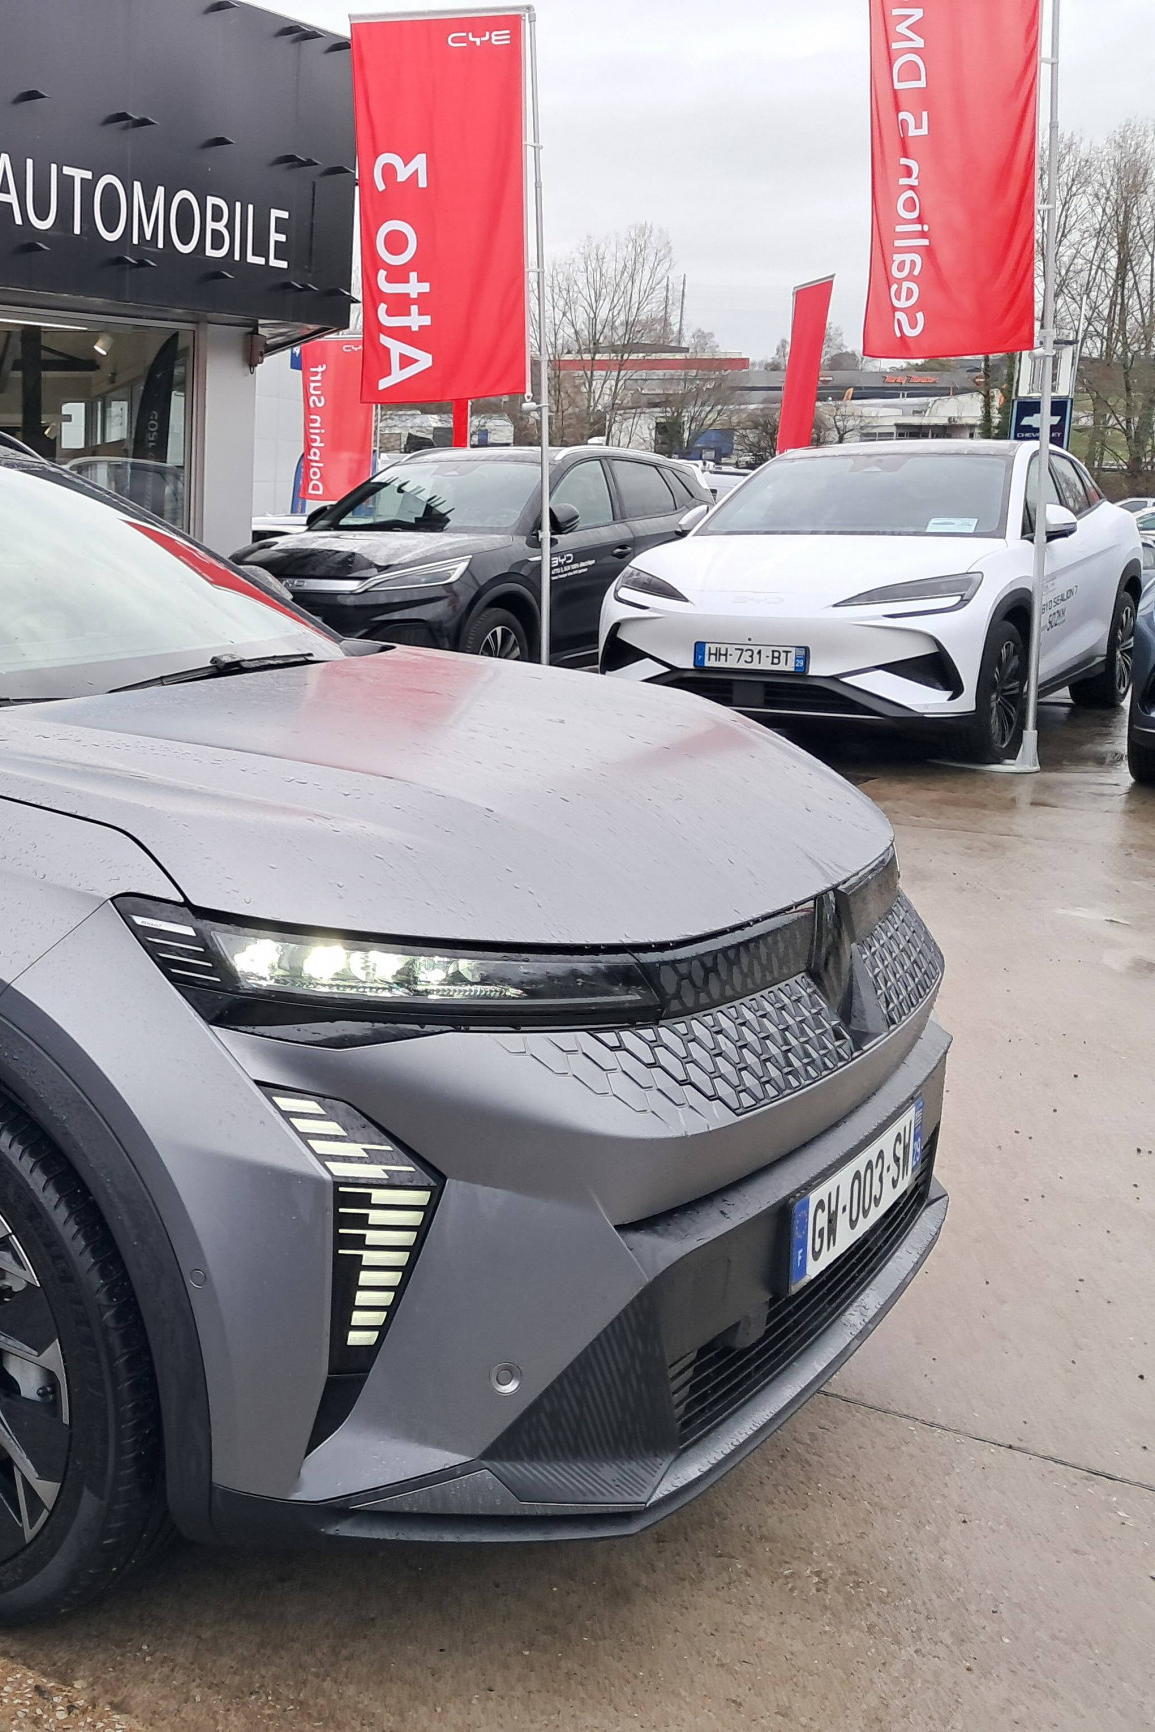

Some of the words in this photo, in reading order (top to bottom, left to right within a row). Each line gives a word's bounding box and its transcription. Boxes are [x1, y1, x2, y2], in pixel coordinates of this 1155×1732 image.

[551, 553, 574, 567] BYD
[707, 646, 792, 666] HH-731-BT
[796, 1249, 803, 1268] F
[811, 1119, 913, 1262] GW-003-SW
